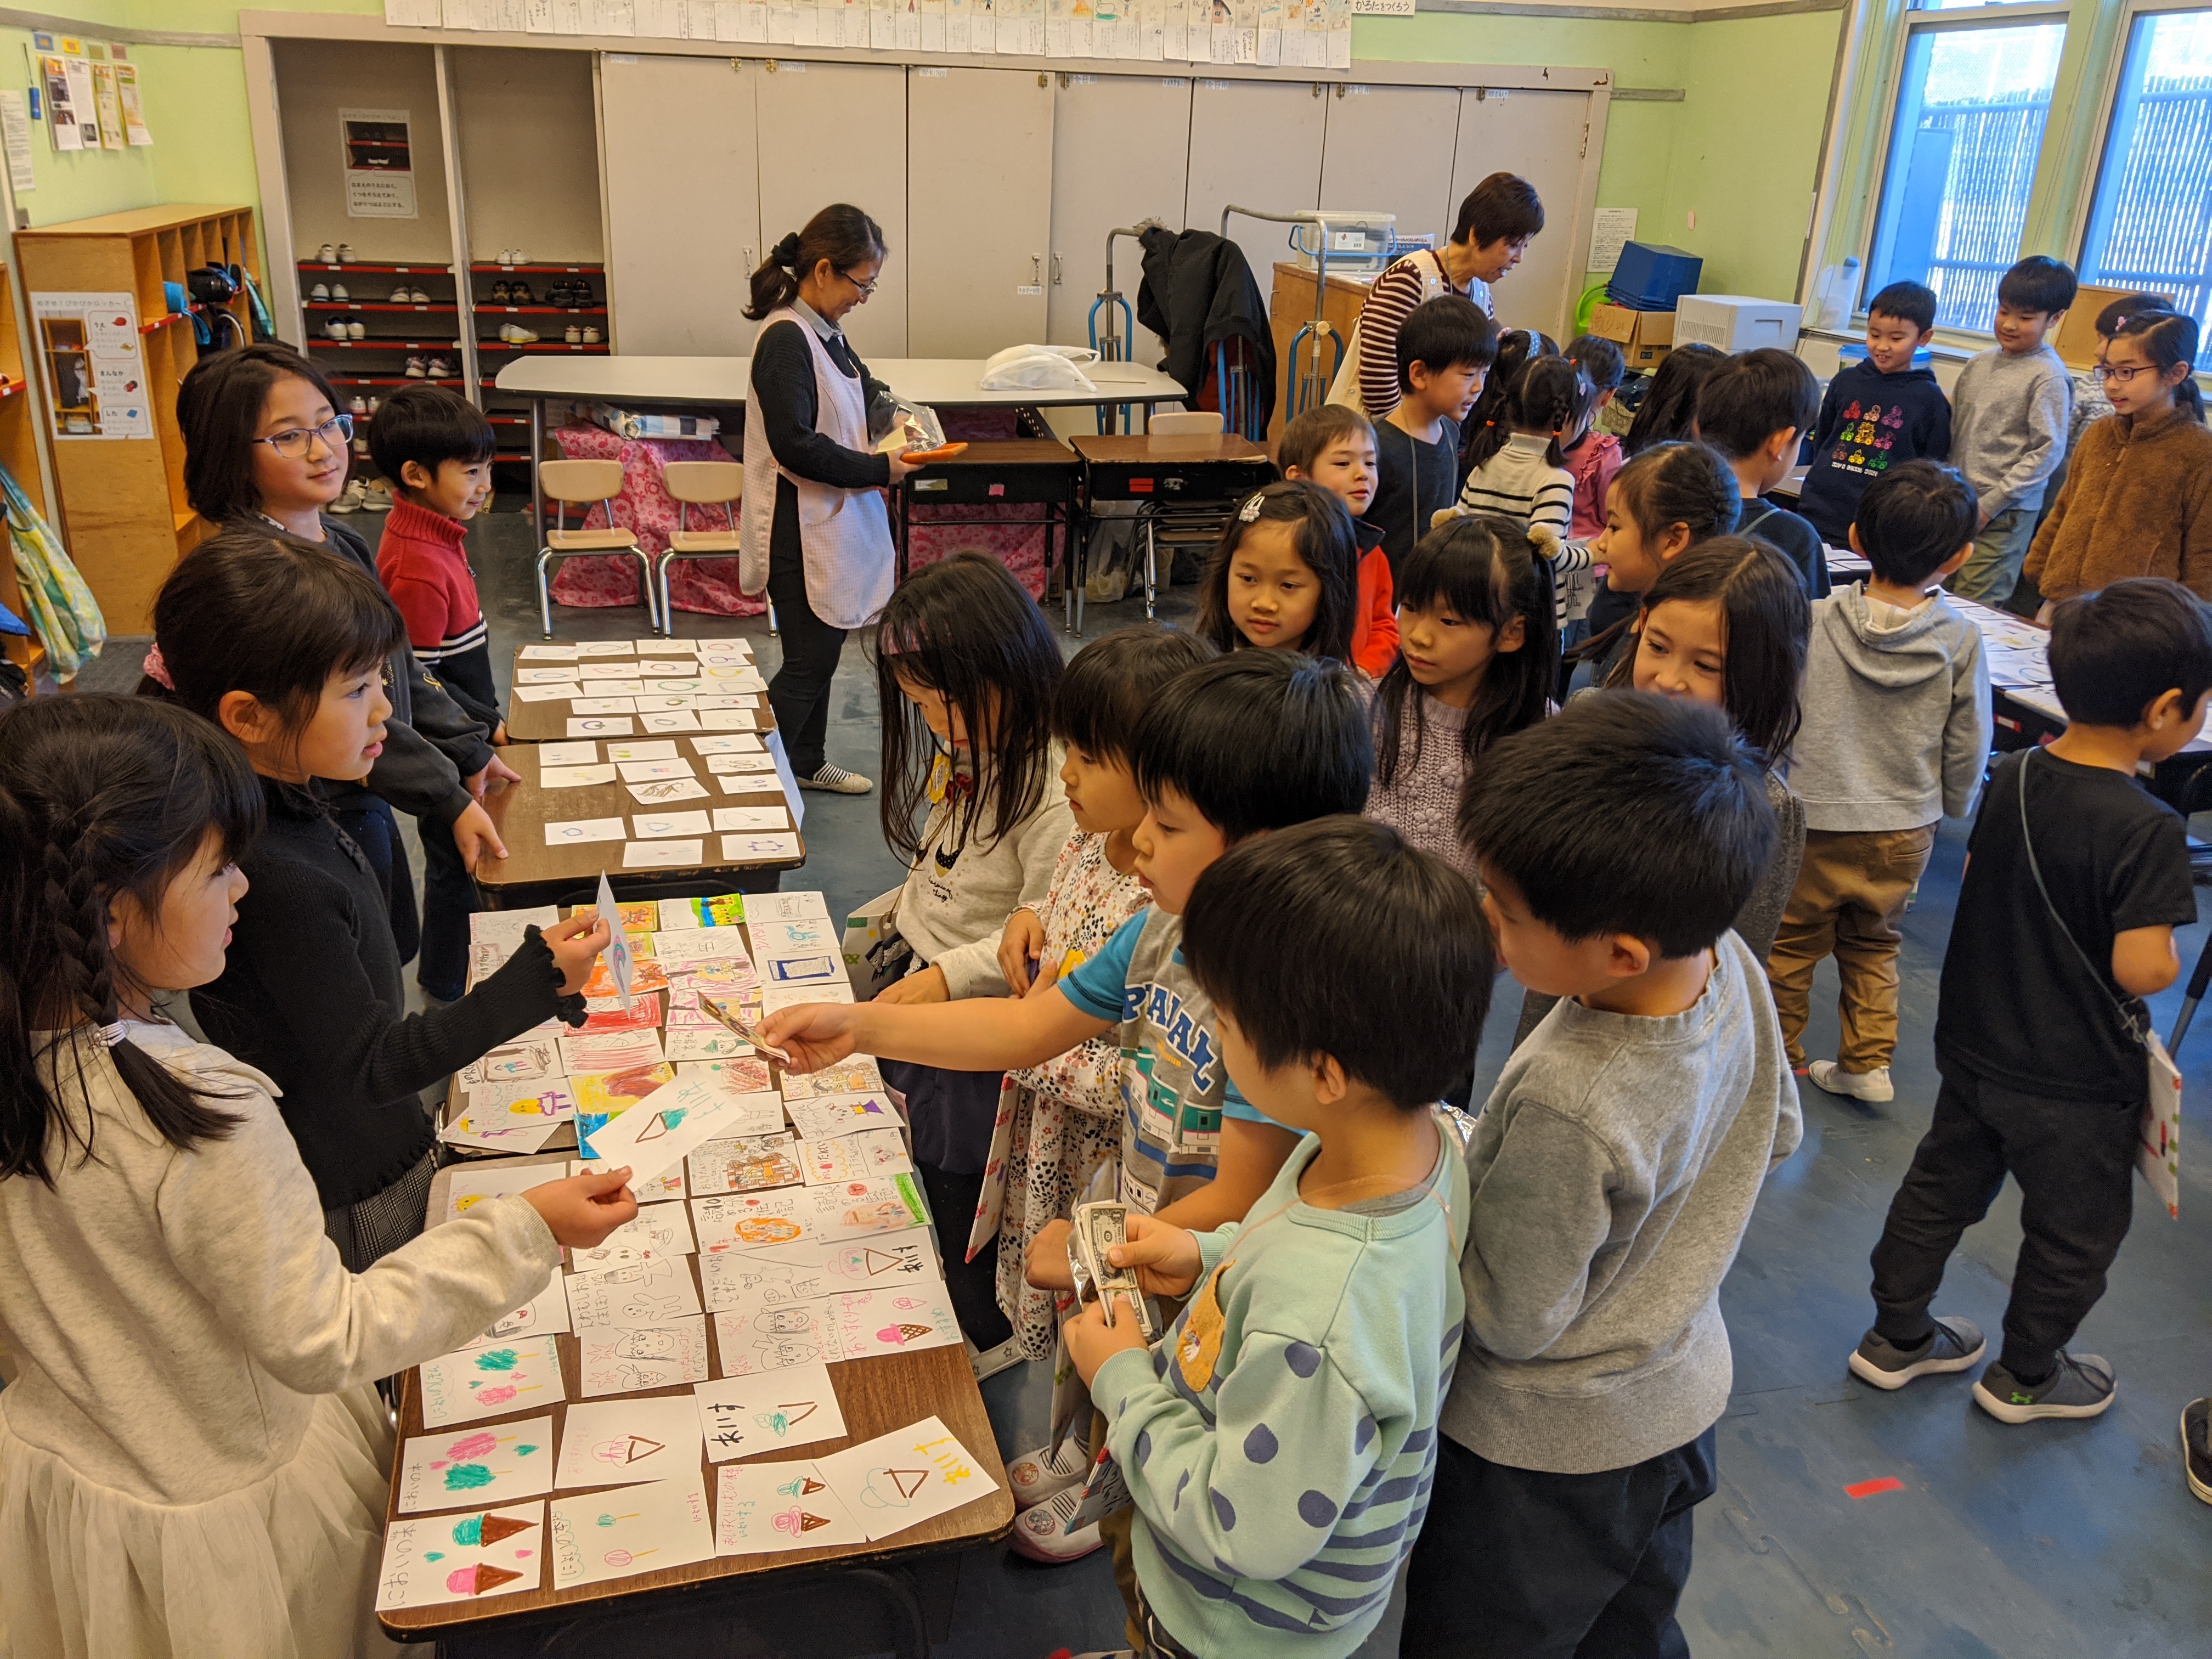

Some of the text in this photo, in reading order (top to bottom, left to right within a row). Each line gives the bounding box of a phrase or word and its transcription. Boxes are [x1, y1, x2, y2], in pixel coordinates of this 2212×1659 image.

[891, 1245, 924, 1273] あいす
[930, 1307, 959, 1341] おすすめ
[707, 1403, 746, 1446] あいす
[912, 1437, 971, 1486] あいす
